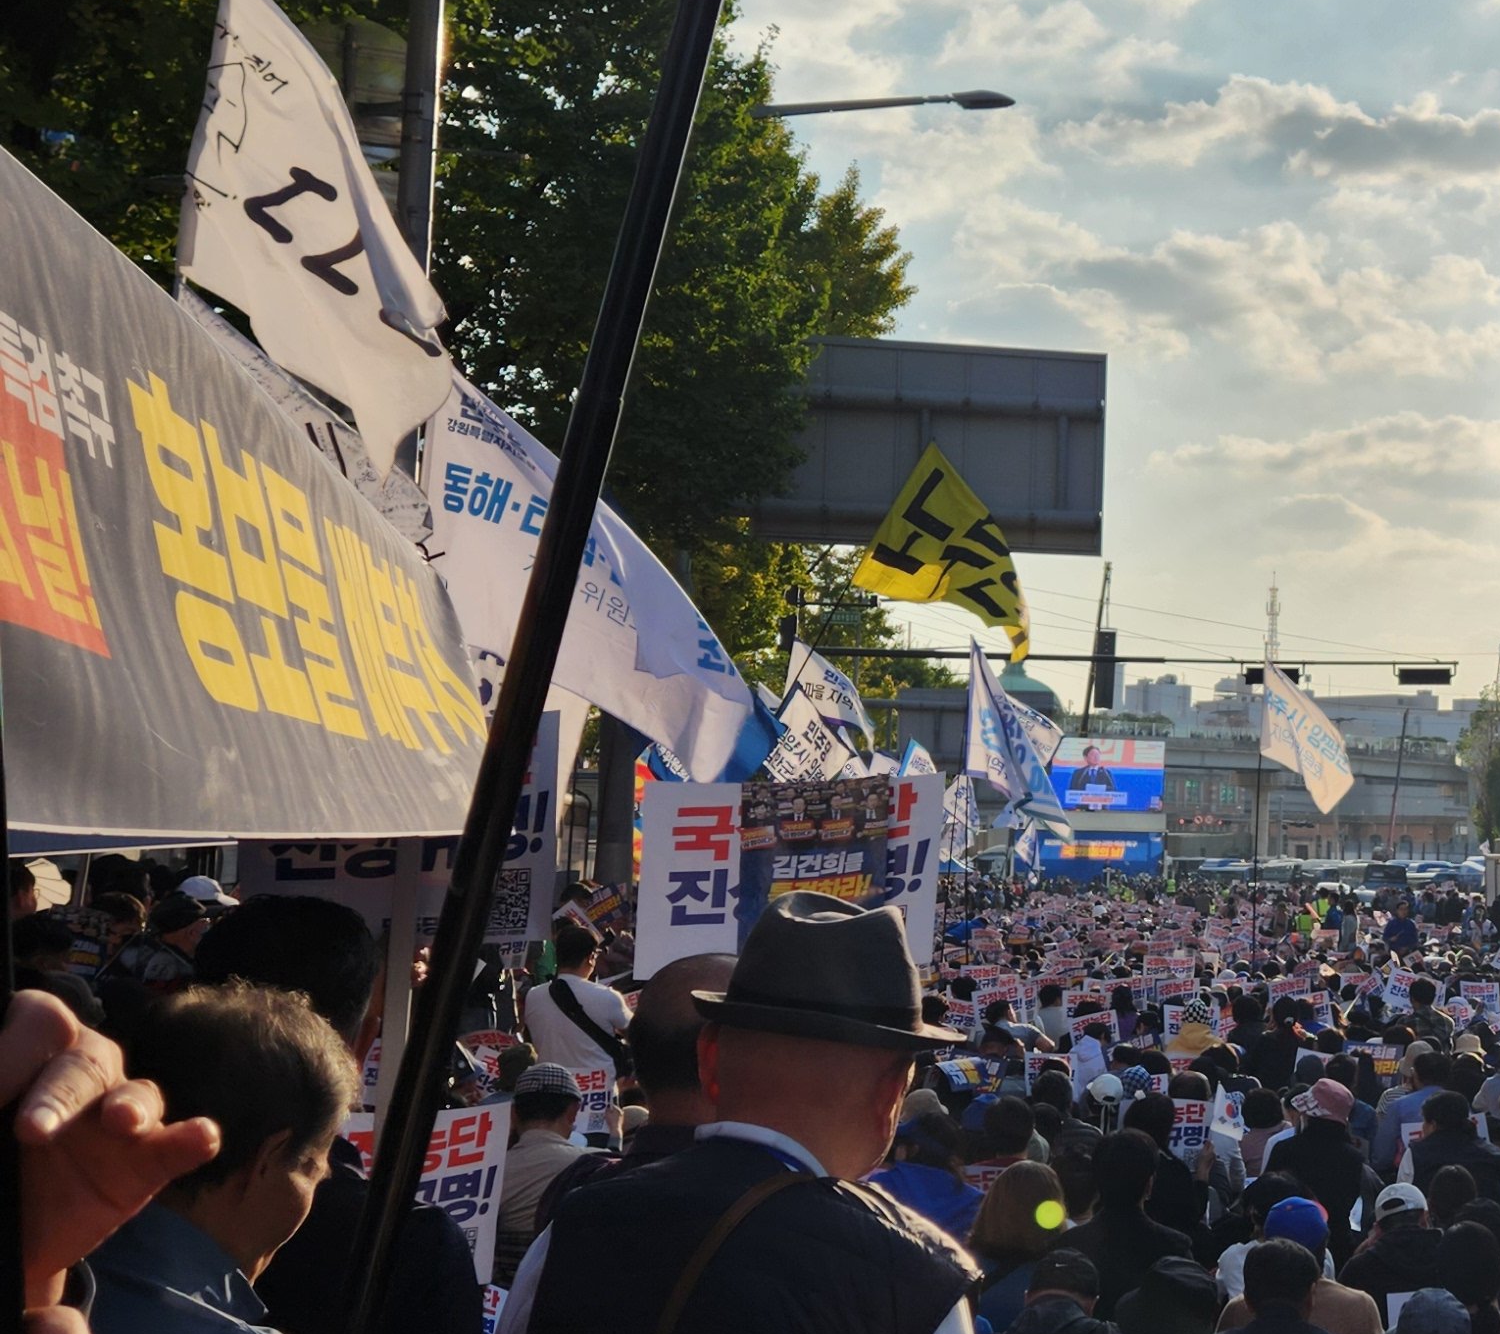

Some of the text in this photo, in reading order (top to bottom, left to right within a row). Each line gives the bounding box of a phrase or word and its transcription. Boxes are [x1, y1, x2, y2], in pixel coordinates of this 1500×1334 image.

[55, 350, 116, 469] 촉구
[126, 369, 368, 742] 홍보물
[772, 851, 865, 879] 김건희를
